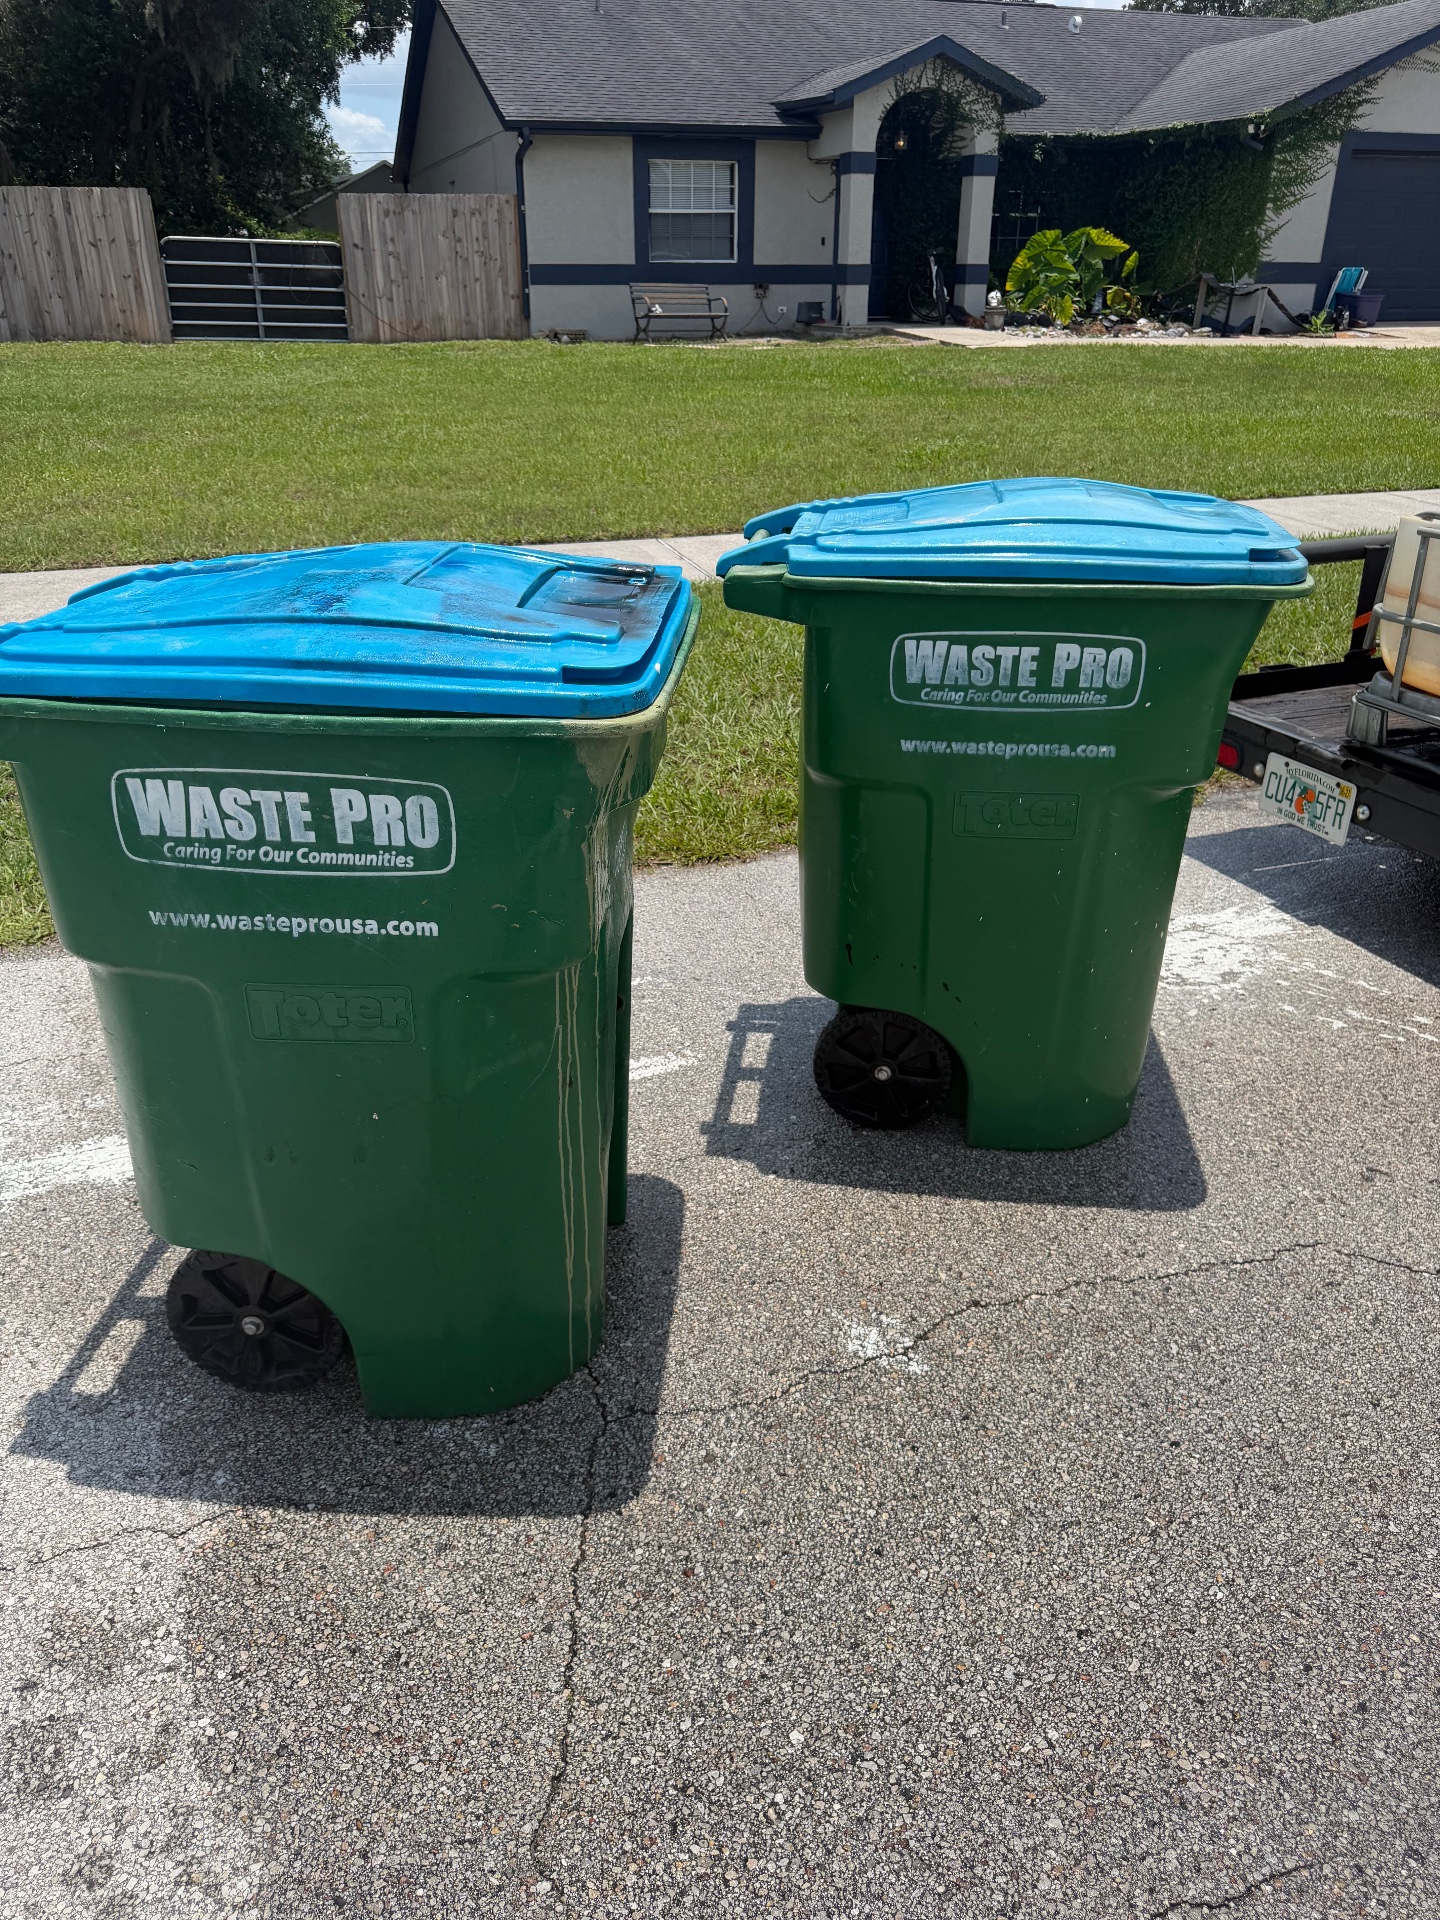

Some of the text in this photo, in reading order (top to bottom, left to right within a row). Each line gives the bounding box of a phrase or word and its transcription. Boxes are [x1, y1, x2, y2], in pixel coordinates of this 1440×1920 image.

[904, 639, 1134, 689] WASTE PRO
[920, 687, 1108, 705] Caring For Our Communities
[900, 738, 1117, 760] www.wasteprousa.com
[1286, 768, 1336, 794] MYFLORIDA.COM
[125, 777, 440, 849] WASTE PRO
[959, 794, 1074, 833] Toter
[1283, 809, 1296, 821] GOD
[1296, 814, 1306, 826] WE
[163, 841, 415, 868] Caring For Our Communities
[148, 910, 439, 938] www.wasteprousa.com
[249, 989, 407, 1037] Toter
